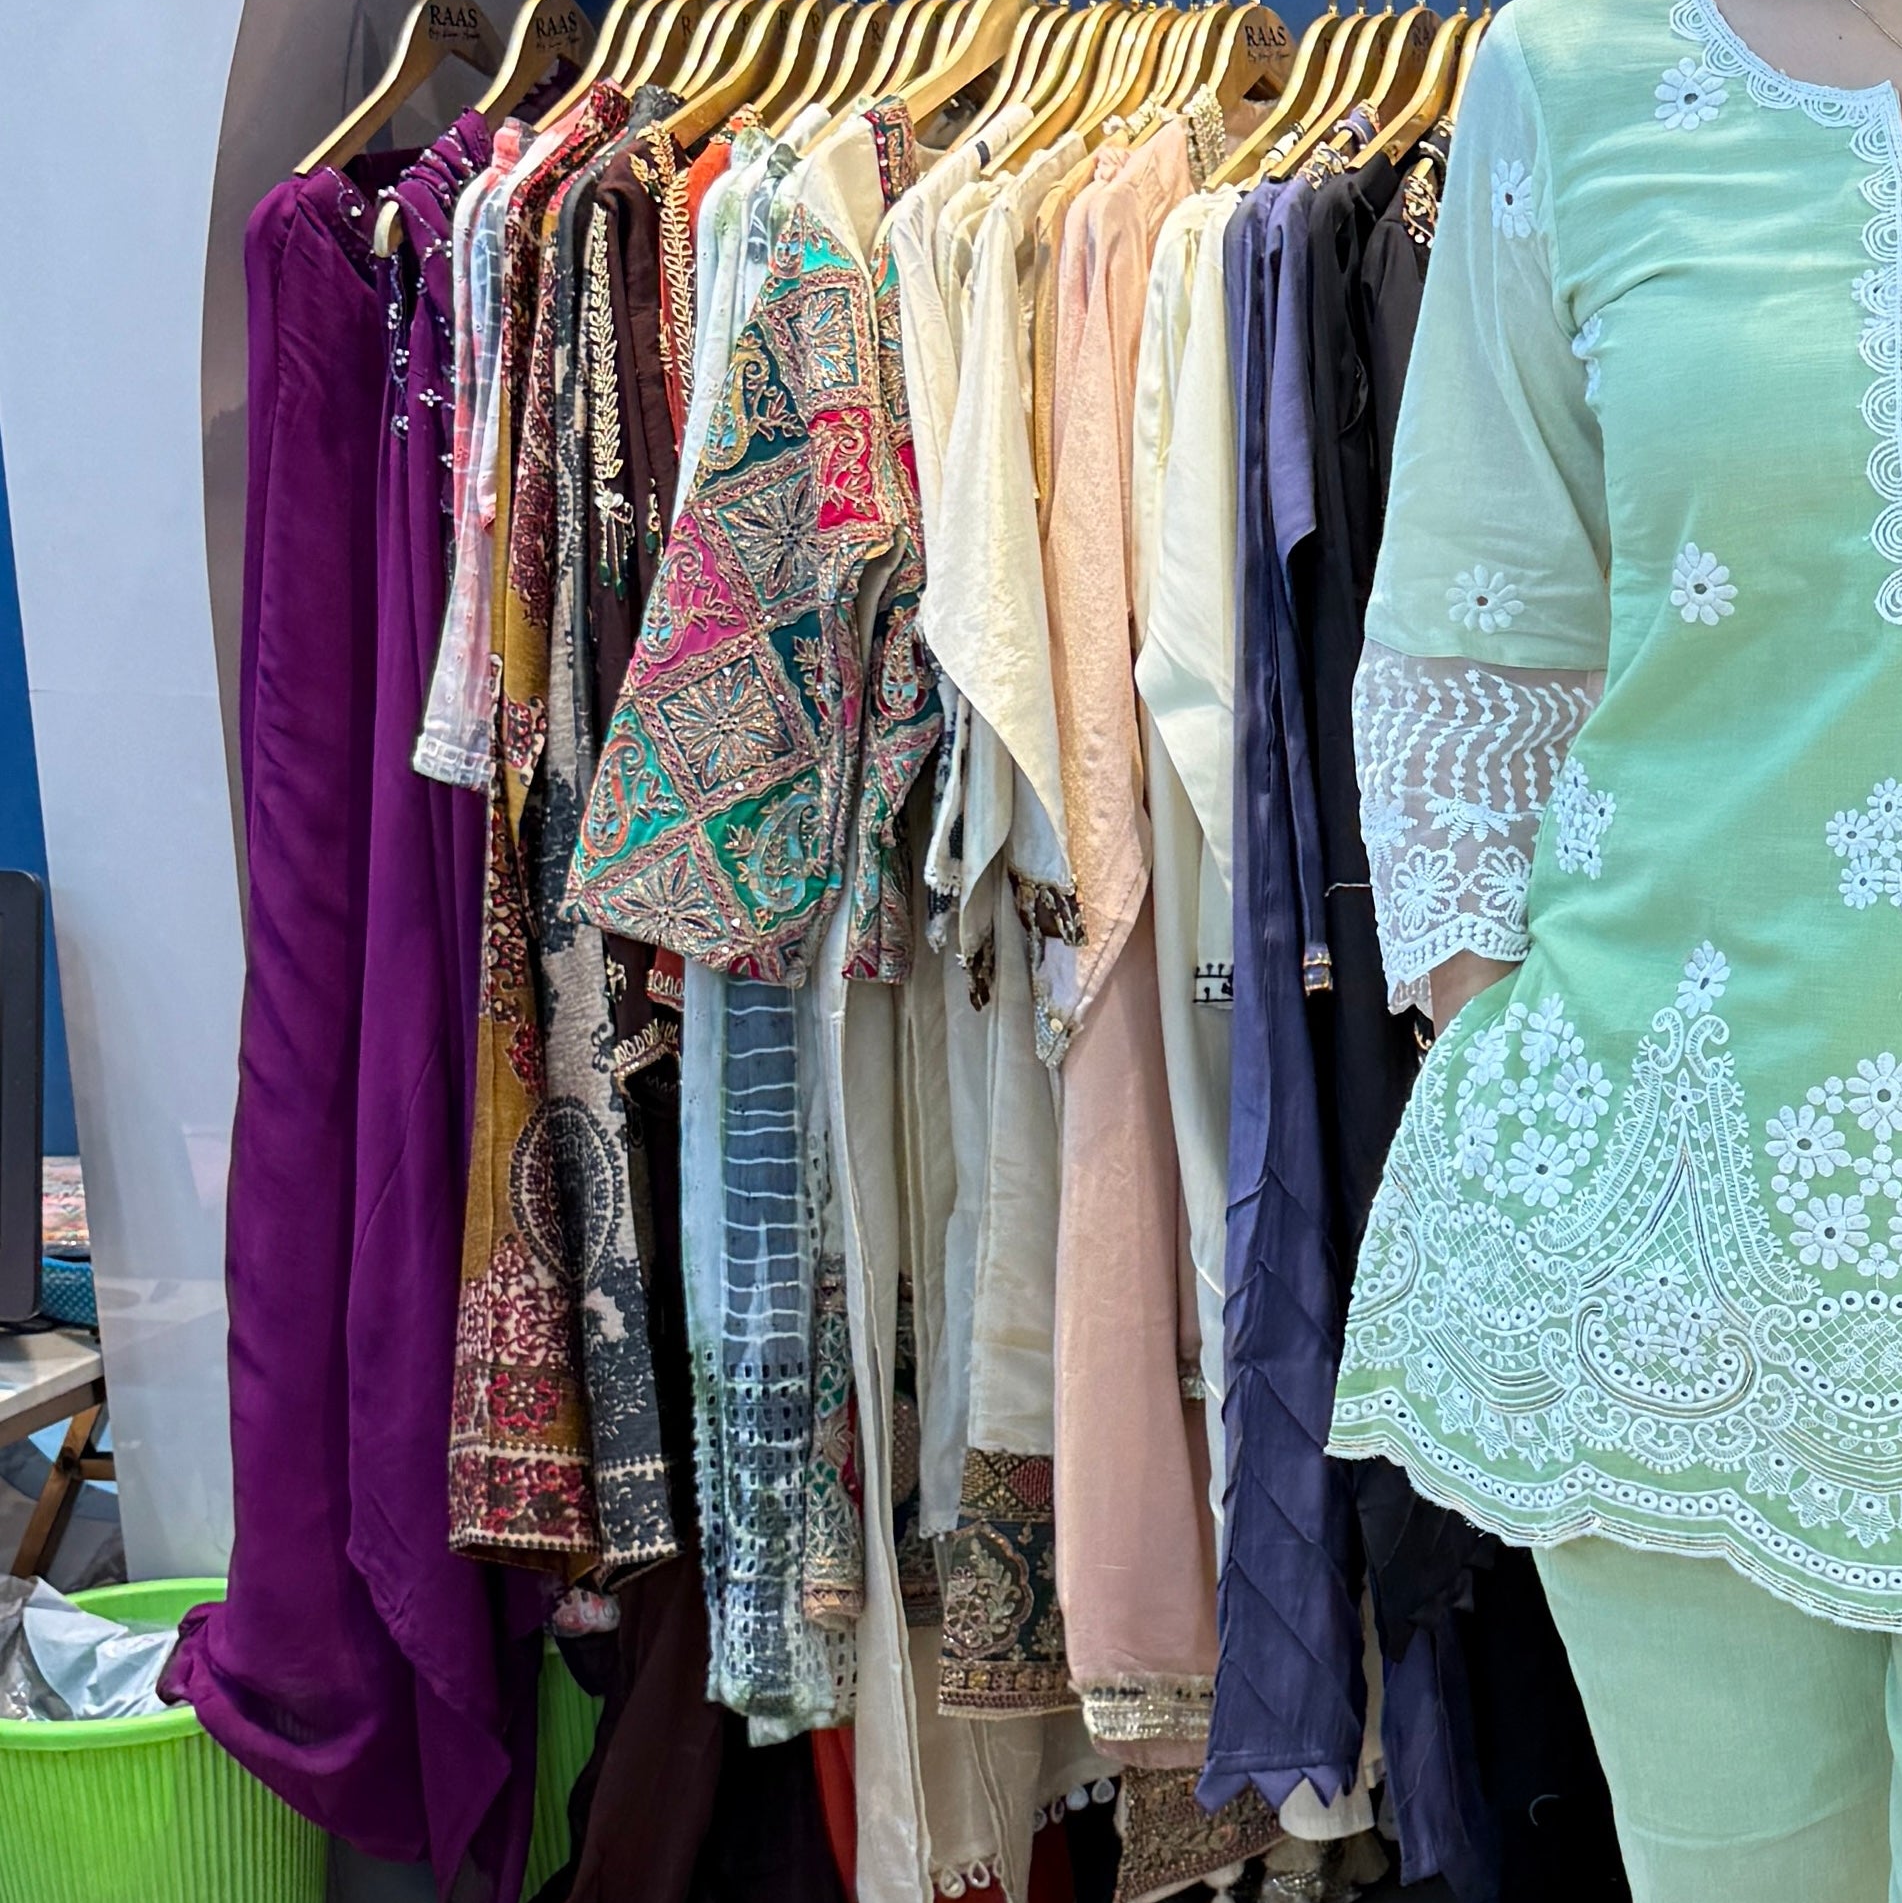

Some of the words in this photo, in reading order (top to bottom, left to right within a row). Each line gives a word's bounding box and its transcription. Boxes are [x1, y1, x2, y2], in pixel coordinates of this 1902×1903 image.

[430, 4, 478, 28] RAAS
[536, 10, 577, 38] RAAS
[1244, 25, 1287, 47] RAAS
